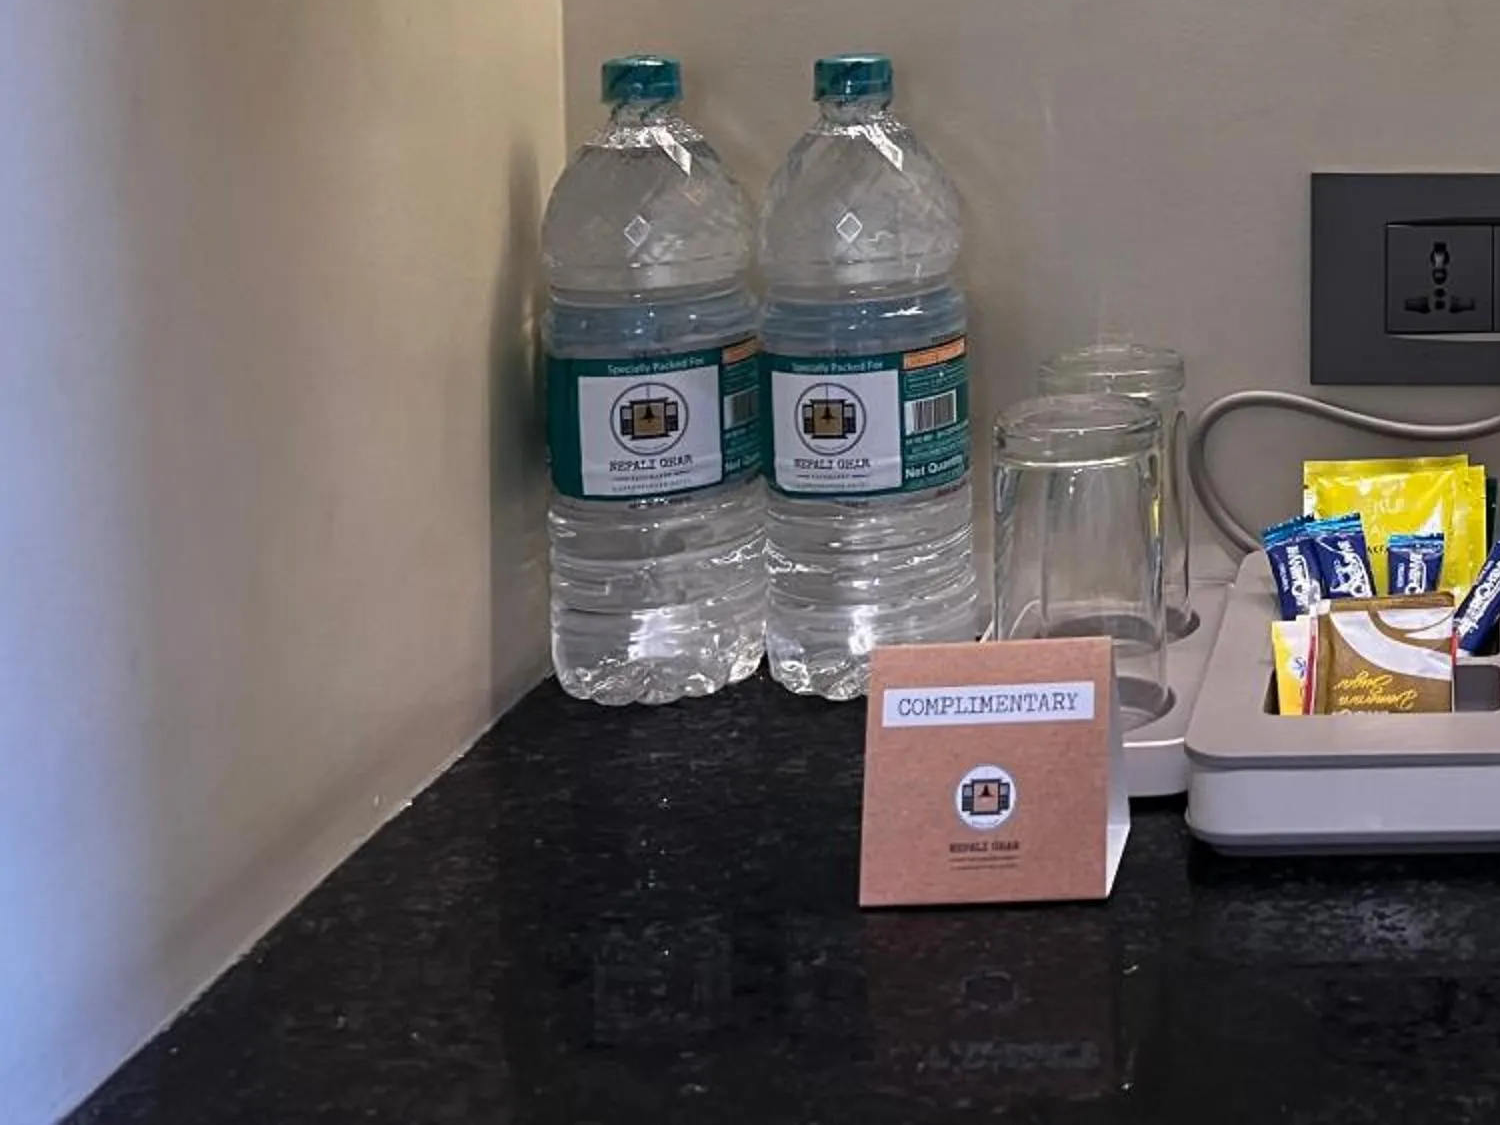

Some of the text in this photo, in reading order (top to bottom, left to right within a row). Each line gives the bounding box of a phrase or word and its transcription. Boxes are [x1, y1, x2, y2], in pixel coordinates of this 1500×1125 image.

[609, 458, 656, 472] NEPALI
[1333, 669, 1393, 694] Sugar
[897, 691, 1080, 717] COMPLIMENTARY
